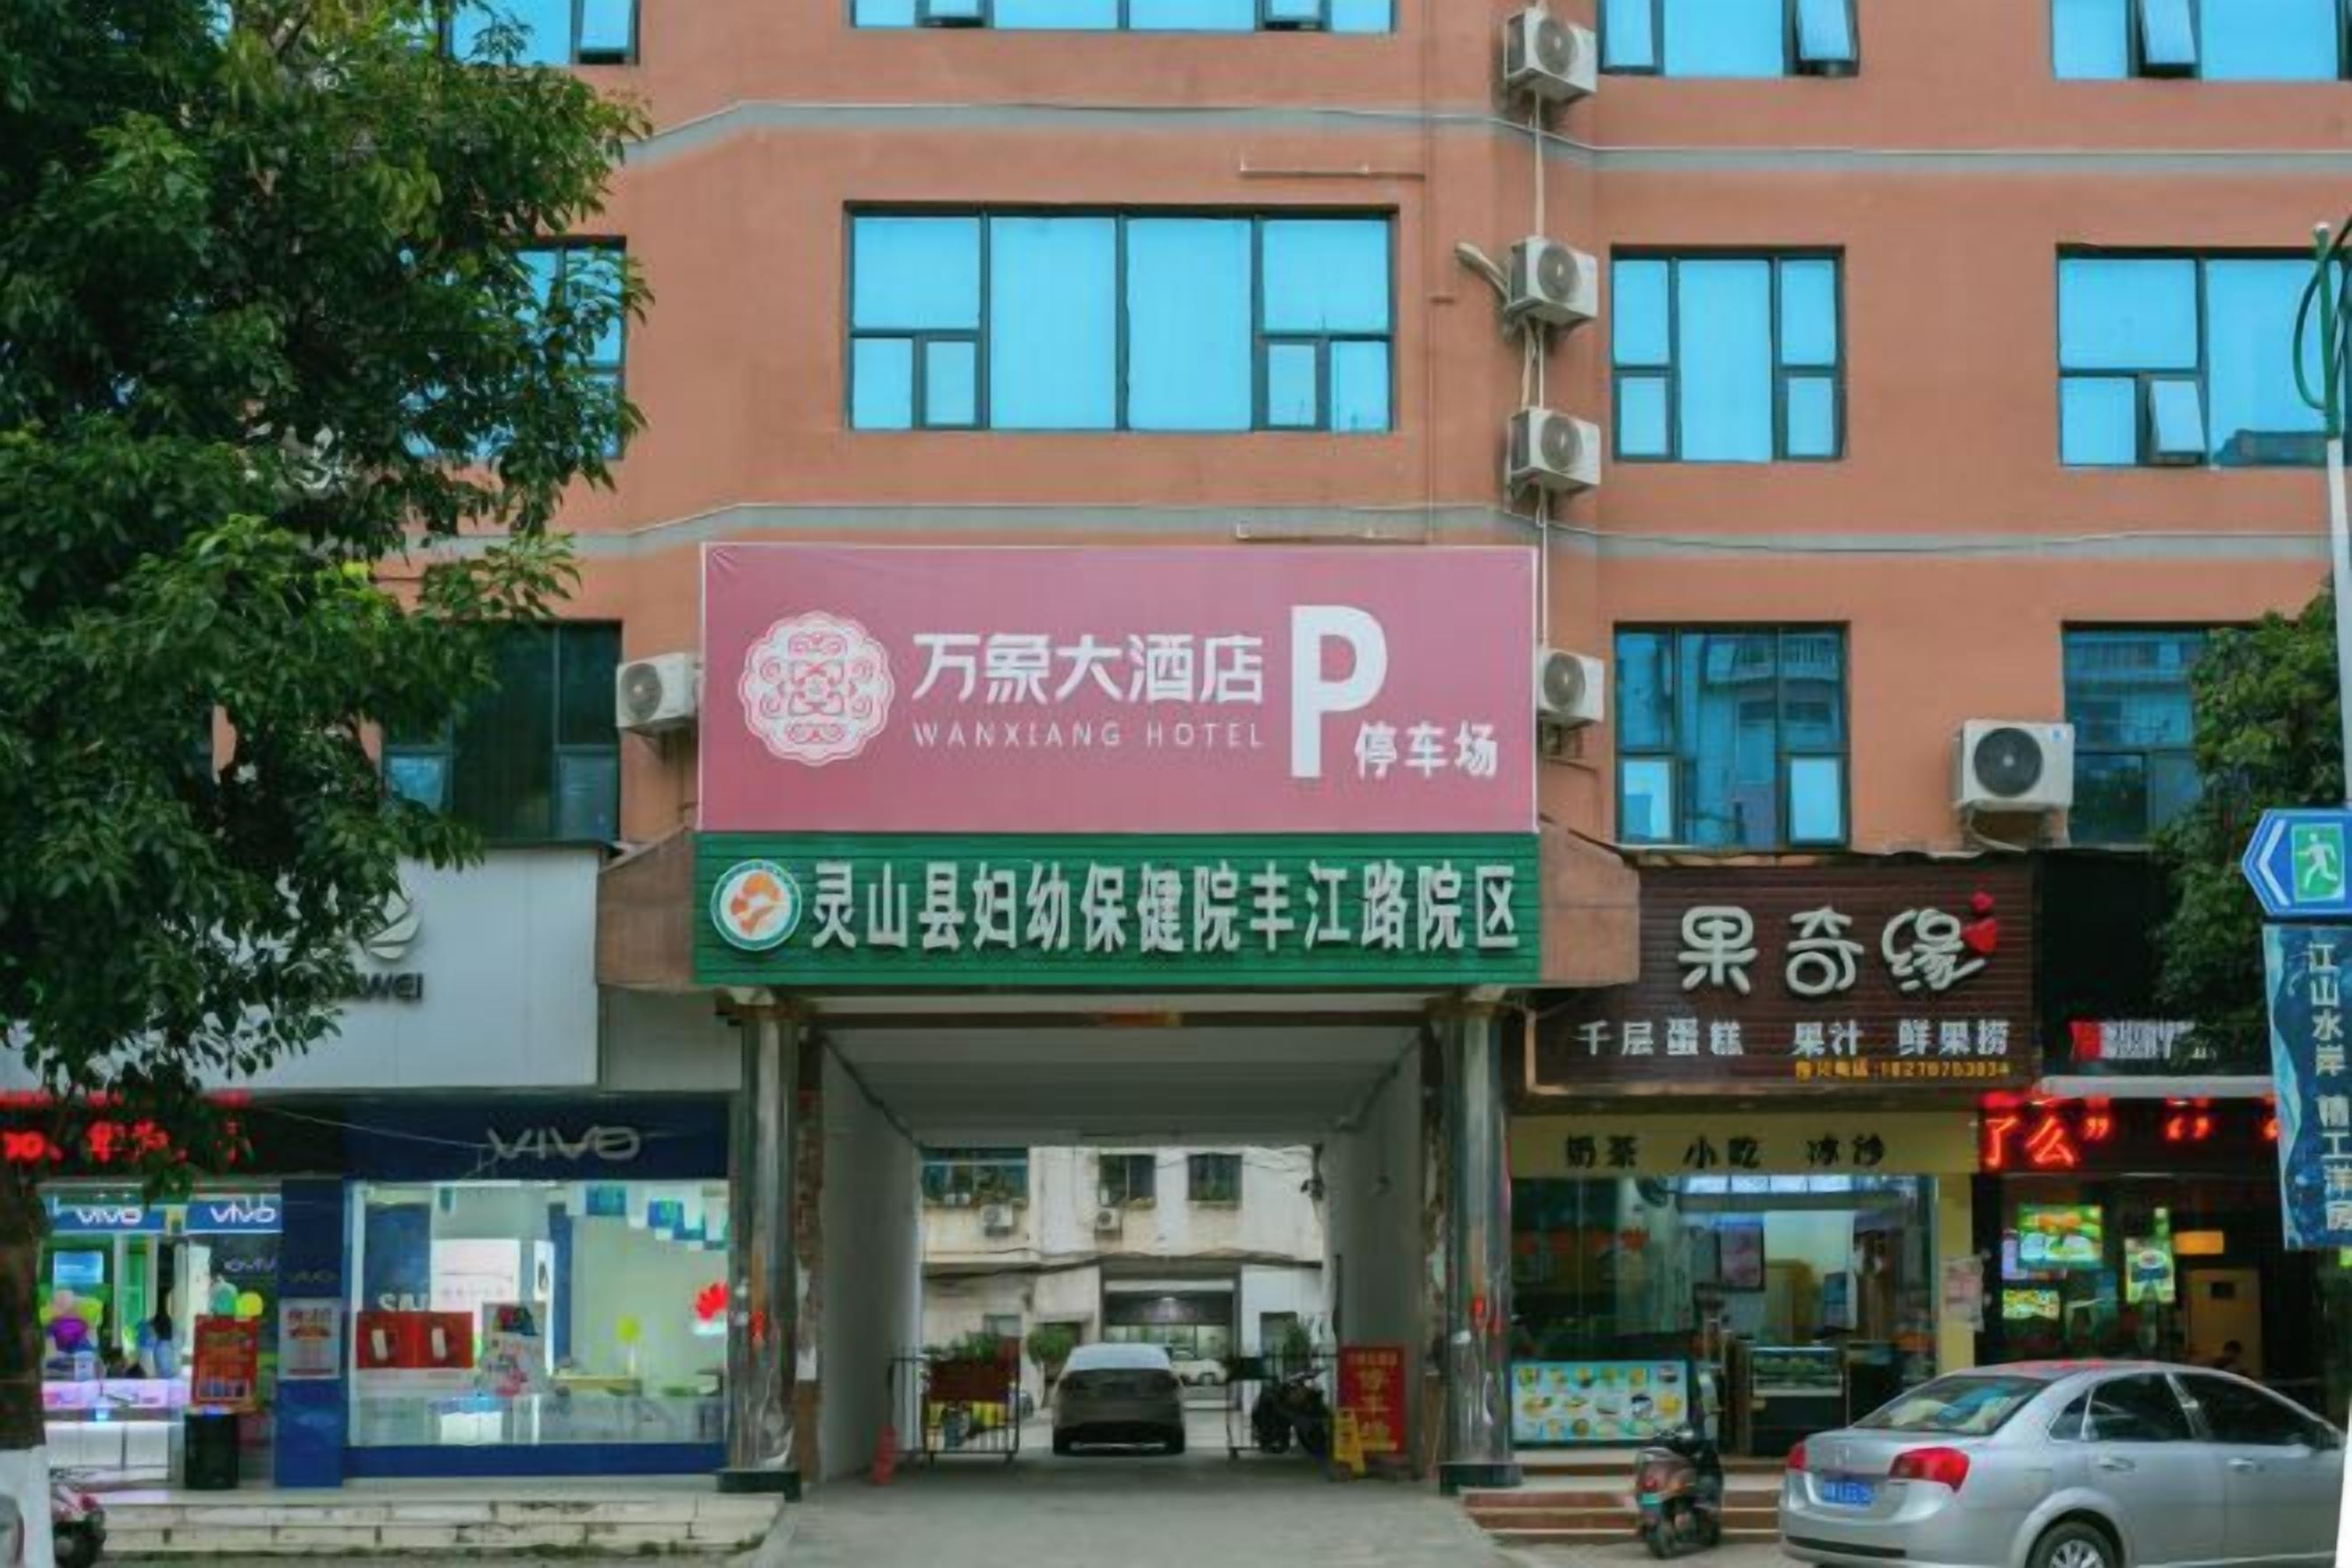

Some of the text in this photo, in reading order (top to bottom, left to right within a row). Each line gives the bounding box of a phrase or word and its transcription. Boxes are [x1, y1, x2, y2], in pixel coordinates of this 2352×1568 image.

[911, 633, 1263, 704] 万象大酒店
[1292, 605, 1388, 778] P
[911, 721, 1264, 748] WANXIANG HOTEL
[1353, 719, 1498, 780] 停车场
[811, 860, 1519, 952] 灵山县妇幼保健院丰江路院区
[1678, 904, 1989, 996] 果奇缘
[1791, 1017, 1864, 1058] 果汁
